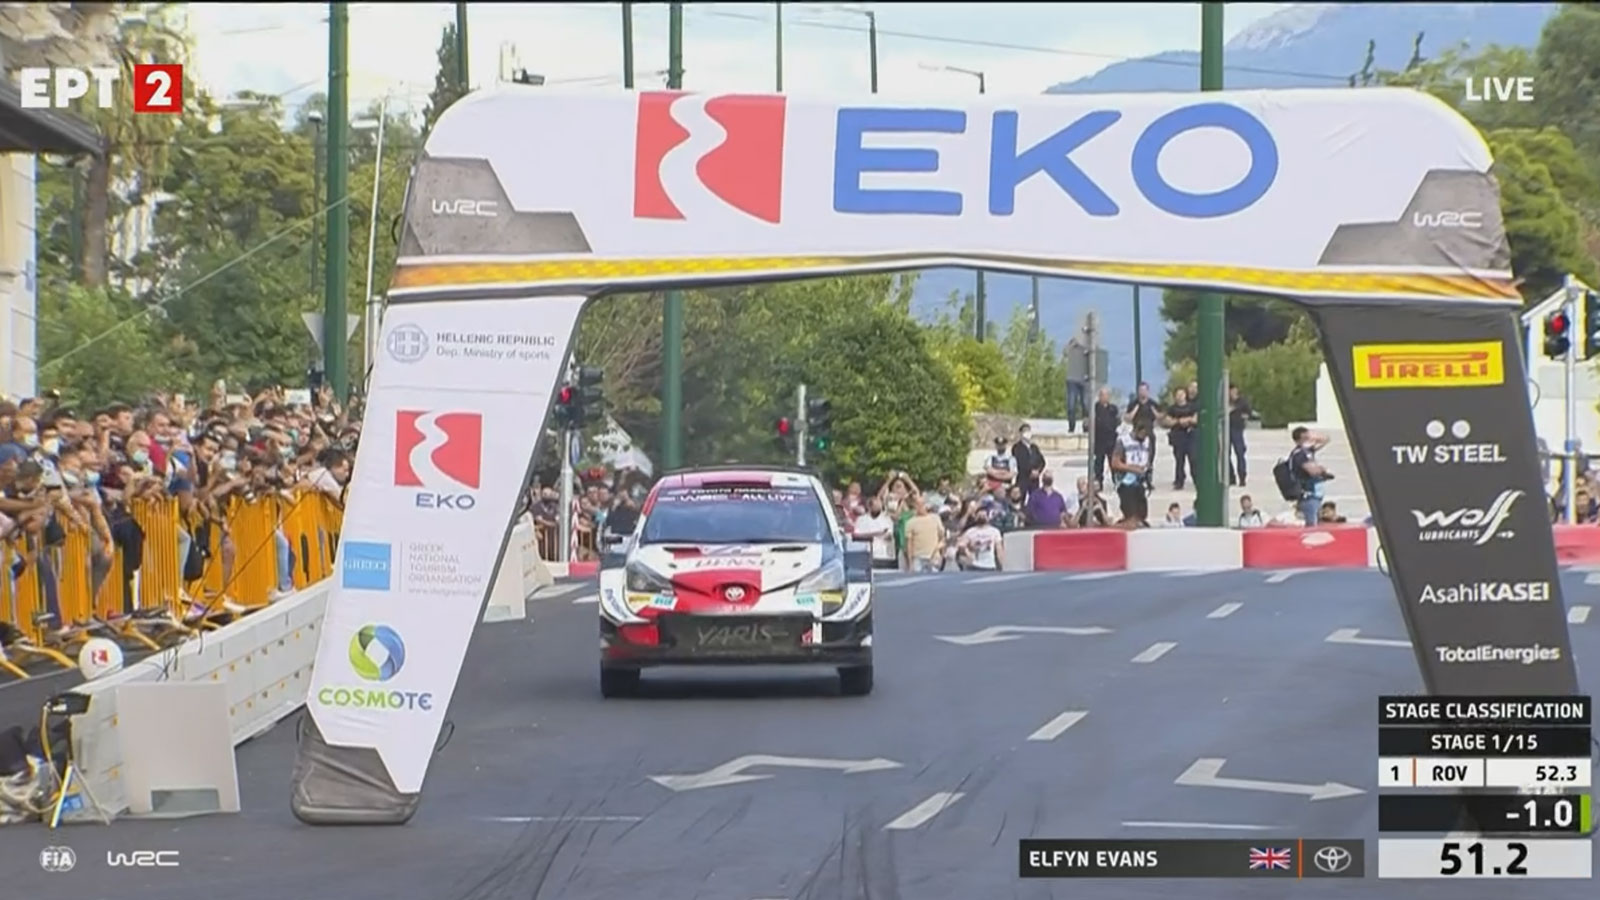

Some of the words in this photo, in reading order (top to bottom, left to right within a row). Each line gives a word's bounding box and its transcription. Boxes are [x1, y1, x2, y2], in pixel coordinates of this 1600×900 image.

[833, 102, 1279, 219] EKO
[431, 198, 498, 217] WRC
[1413, 210, 1481, 229] WRC
[436, 332, 493, 345] HELLENIC
[497, 334, 555, 346] REPUBLIC
[463, 348, 502, 359] Ministry
[506, 349, 516, 359] of
[519, 350, 550, 361] sports
[1368, 351, 1489, 379] PIRELLI
[1392, 444, 1427, 464] TW
[1434, 443, 1507, 464] STEEL
[415, 493, 476, 509] EKO
[1418, 530, 1480, 541] LUBRICANTS
[409, 553, 460, 563] NATIONAL
[410, 564, 456, 573] TOURISM
[408, 575, 482, 584] ORGANISATION
[1419, 582, 1551, 604] AsahiKASEI
[697, 624, 772, 646] YARIS
[1435, 643, 1560, 664] TotalEnergies
[318, 688, 433, 711] COSMOTE
